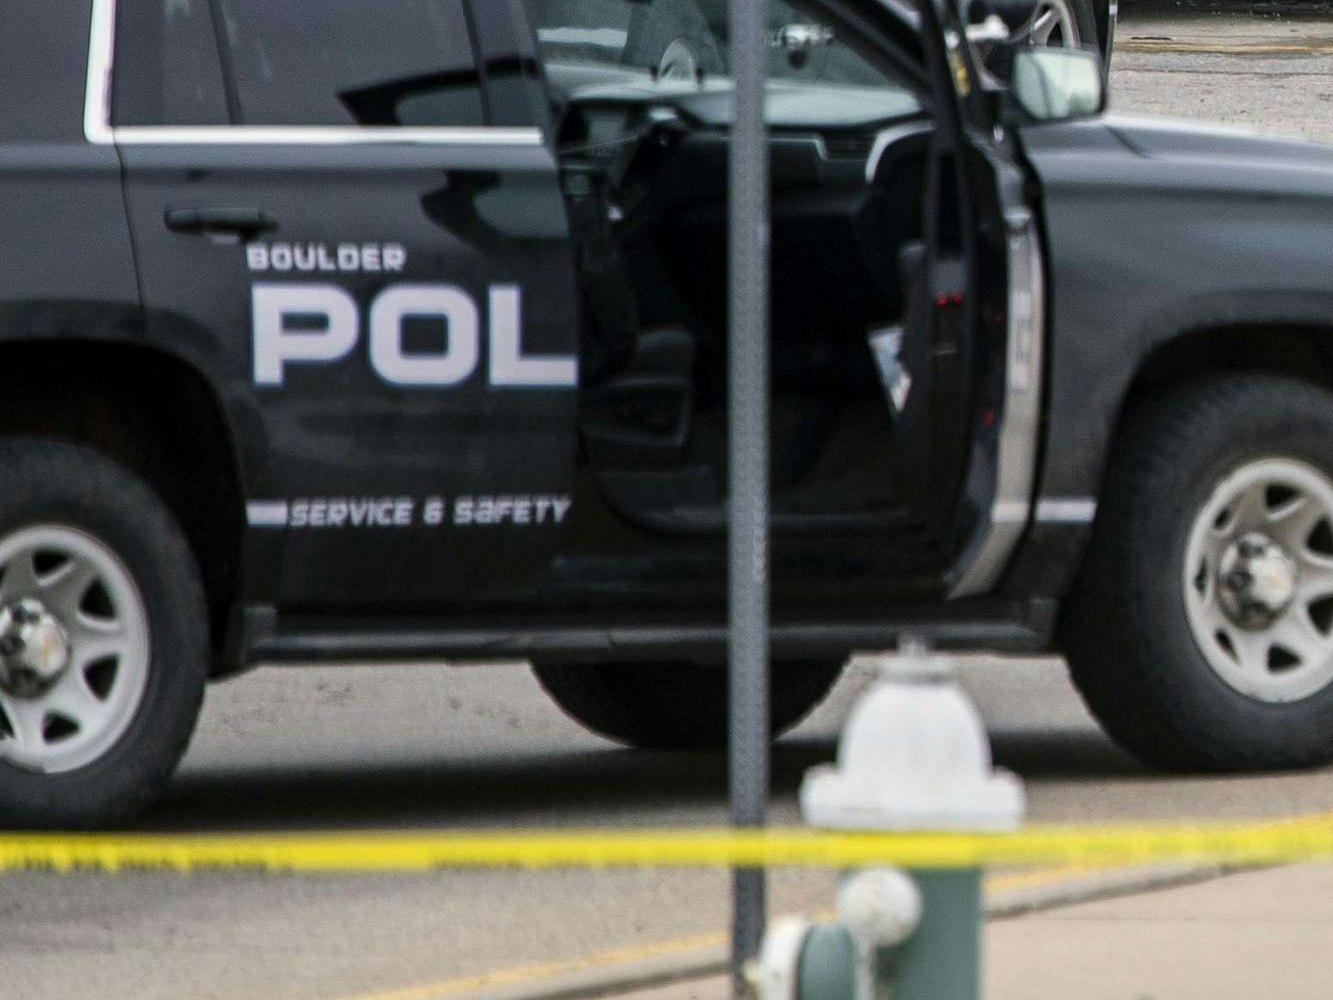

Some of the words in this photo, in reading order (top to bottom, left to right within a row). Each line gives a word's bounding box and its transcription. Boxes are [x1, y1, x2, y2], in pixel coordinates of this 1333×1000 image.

[246, 243, 407, 271] BOULDER
[252, 282, 580, 388] POL
[290, 499, 415, 527] SERVICE
